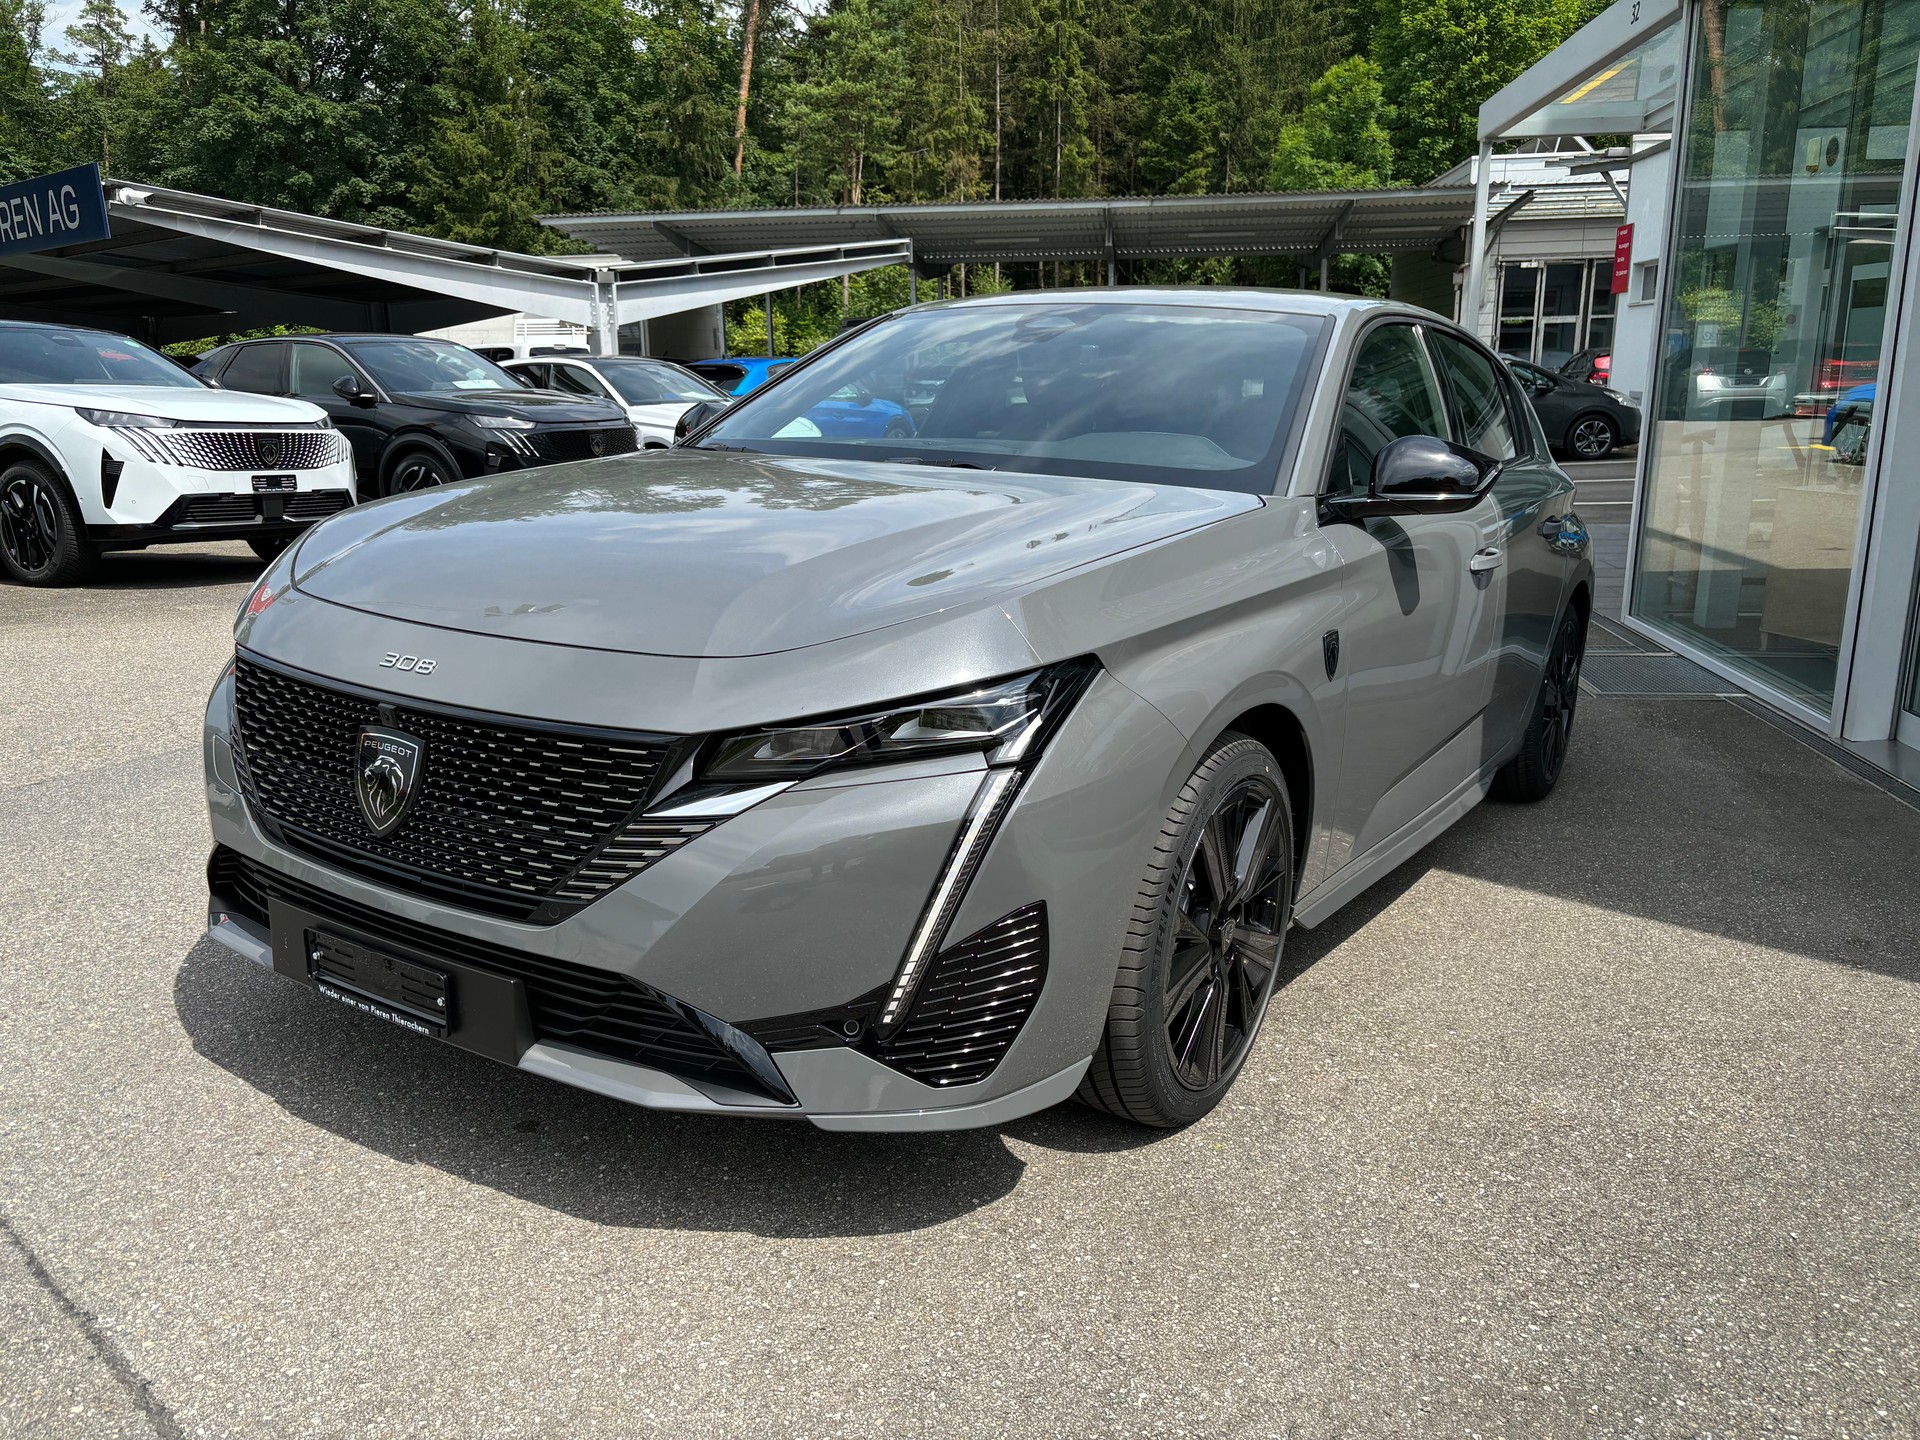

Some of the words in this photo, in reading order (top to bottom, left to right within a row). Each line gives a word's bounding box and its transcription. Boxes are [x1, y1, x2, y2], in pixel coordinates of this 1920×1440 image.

[1631, 1, 1640, 25] 32
[0, 193, 43, 242] REN
[48, 184, 80, 233] AG
[379, 651, 438, 675] 308
[364, 740, 412, 758] PEUGEOT
[318, 984, 341, 1000] Wieder
[341, 994, 357, 1006] einer
[358, 1002, 370, 1012] von
[370, 1005, 391, 1020] Pieren
